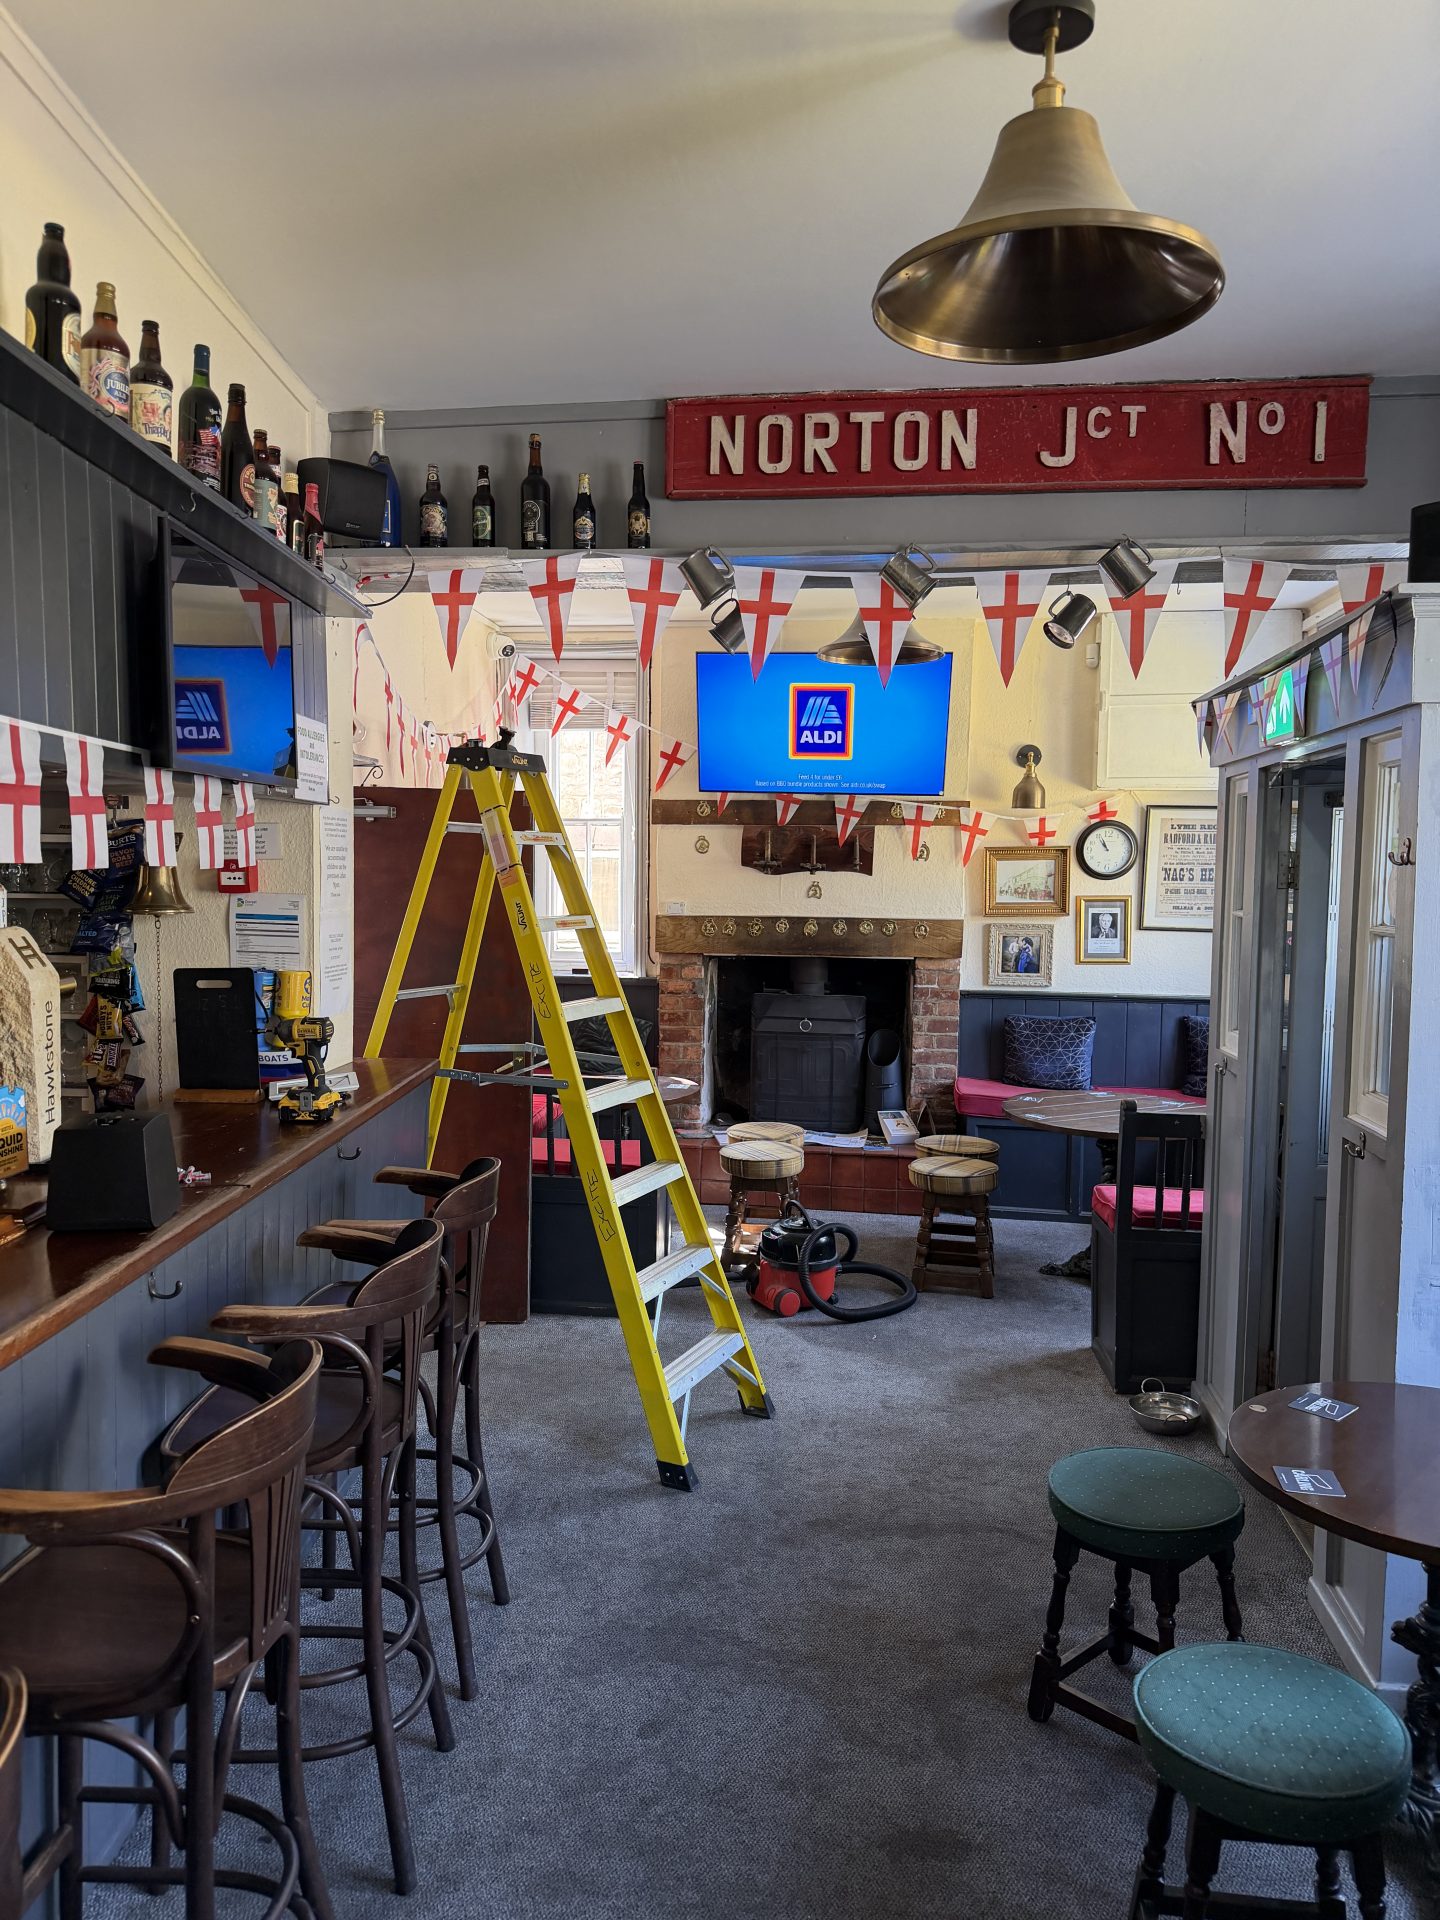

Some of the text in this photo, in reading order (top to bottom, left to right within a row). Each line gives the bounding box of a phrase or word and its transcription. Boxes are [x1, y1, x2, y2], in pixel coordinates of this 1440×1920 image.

[710, 409, 978, 475] NORTON
[800, 731, 842, 744] ALDI
[1105, 830, 1113, 838] 12
[515, 900, 528, 932] VAUNT
[45, 1000, 55, 1125] Hawkstone
